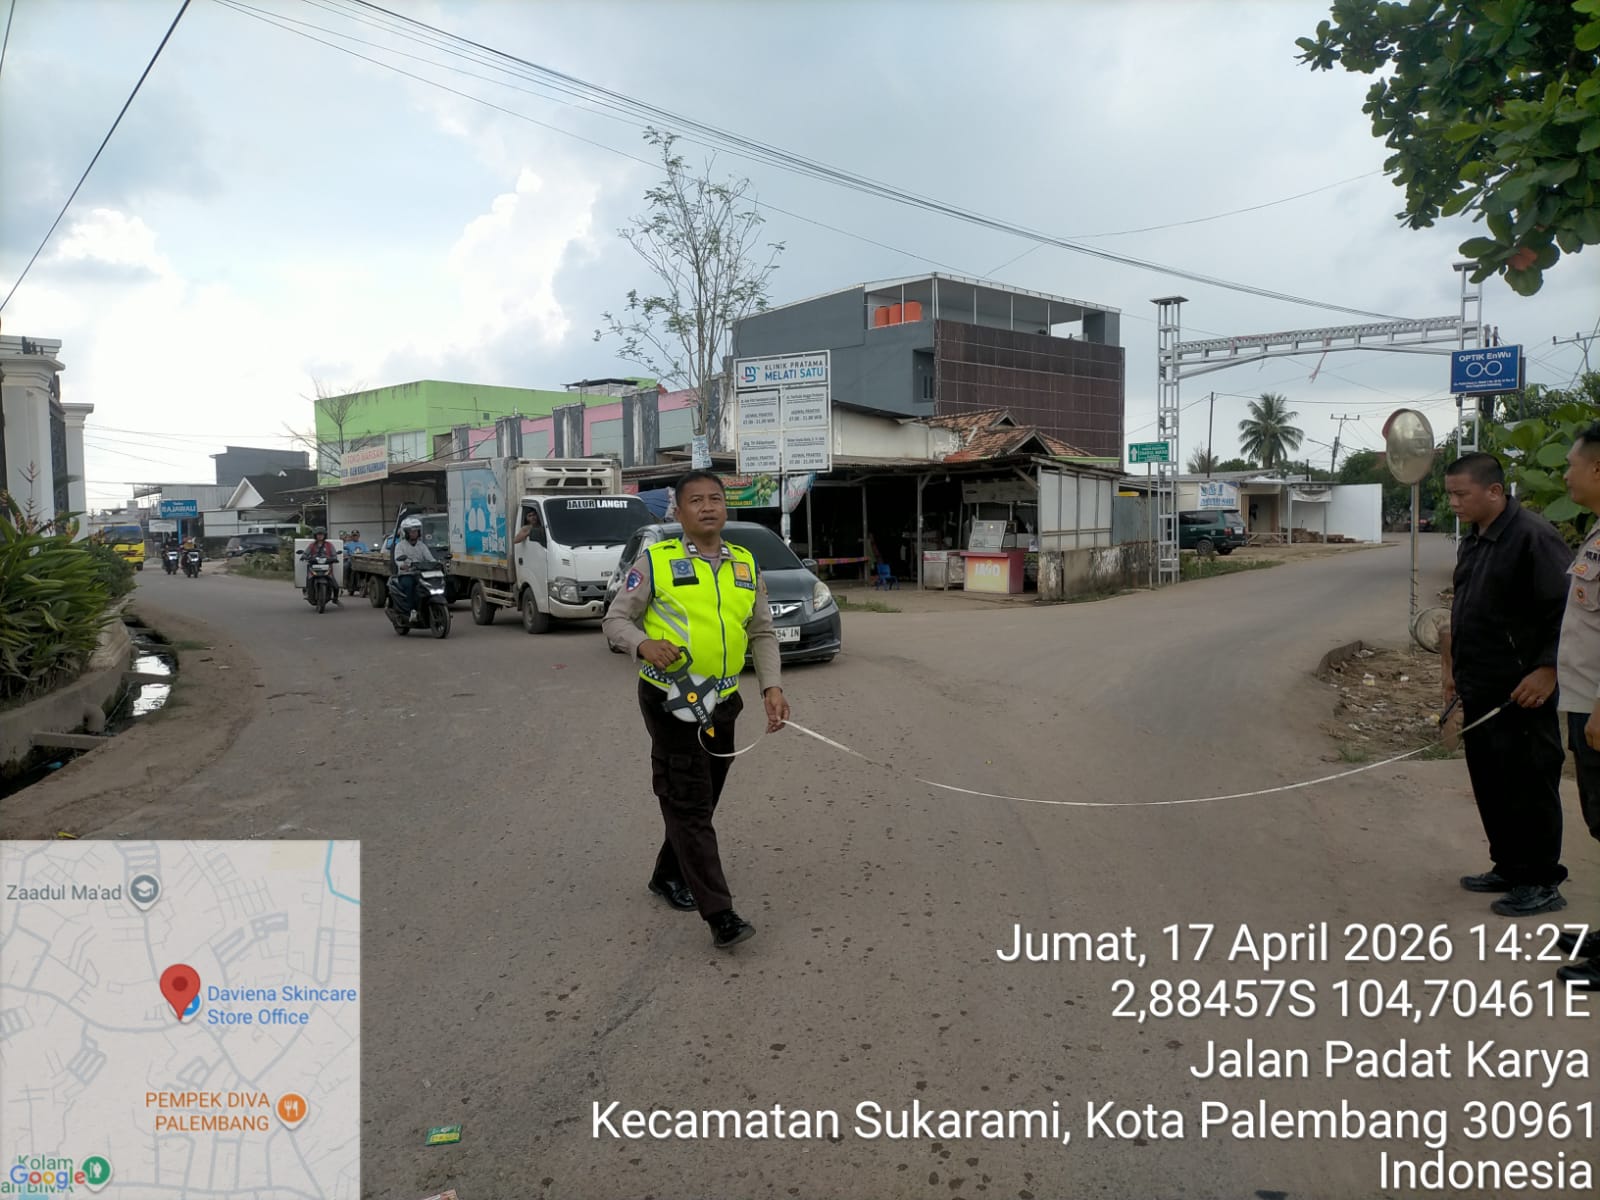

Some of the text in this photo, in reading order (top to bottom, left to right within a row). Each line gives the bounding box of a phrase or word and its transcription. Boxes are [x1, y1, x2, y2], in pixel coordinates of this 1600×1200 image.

[1458, 351, 1512, 363] OPTIK EnWu
[764, 360, 823, 371] KLINIK PRATAMA
[764, 367, 824, 382] MELATI SATU
[161, 505, 196, 513] RAJAWALI
[567, 500, 628, 510] JALUR LANGIT
